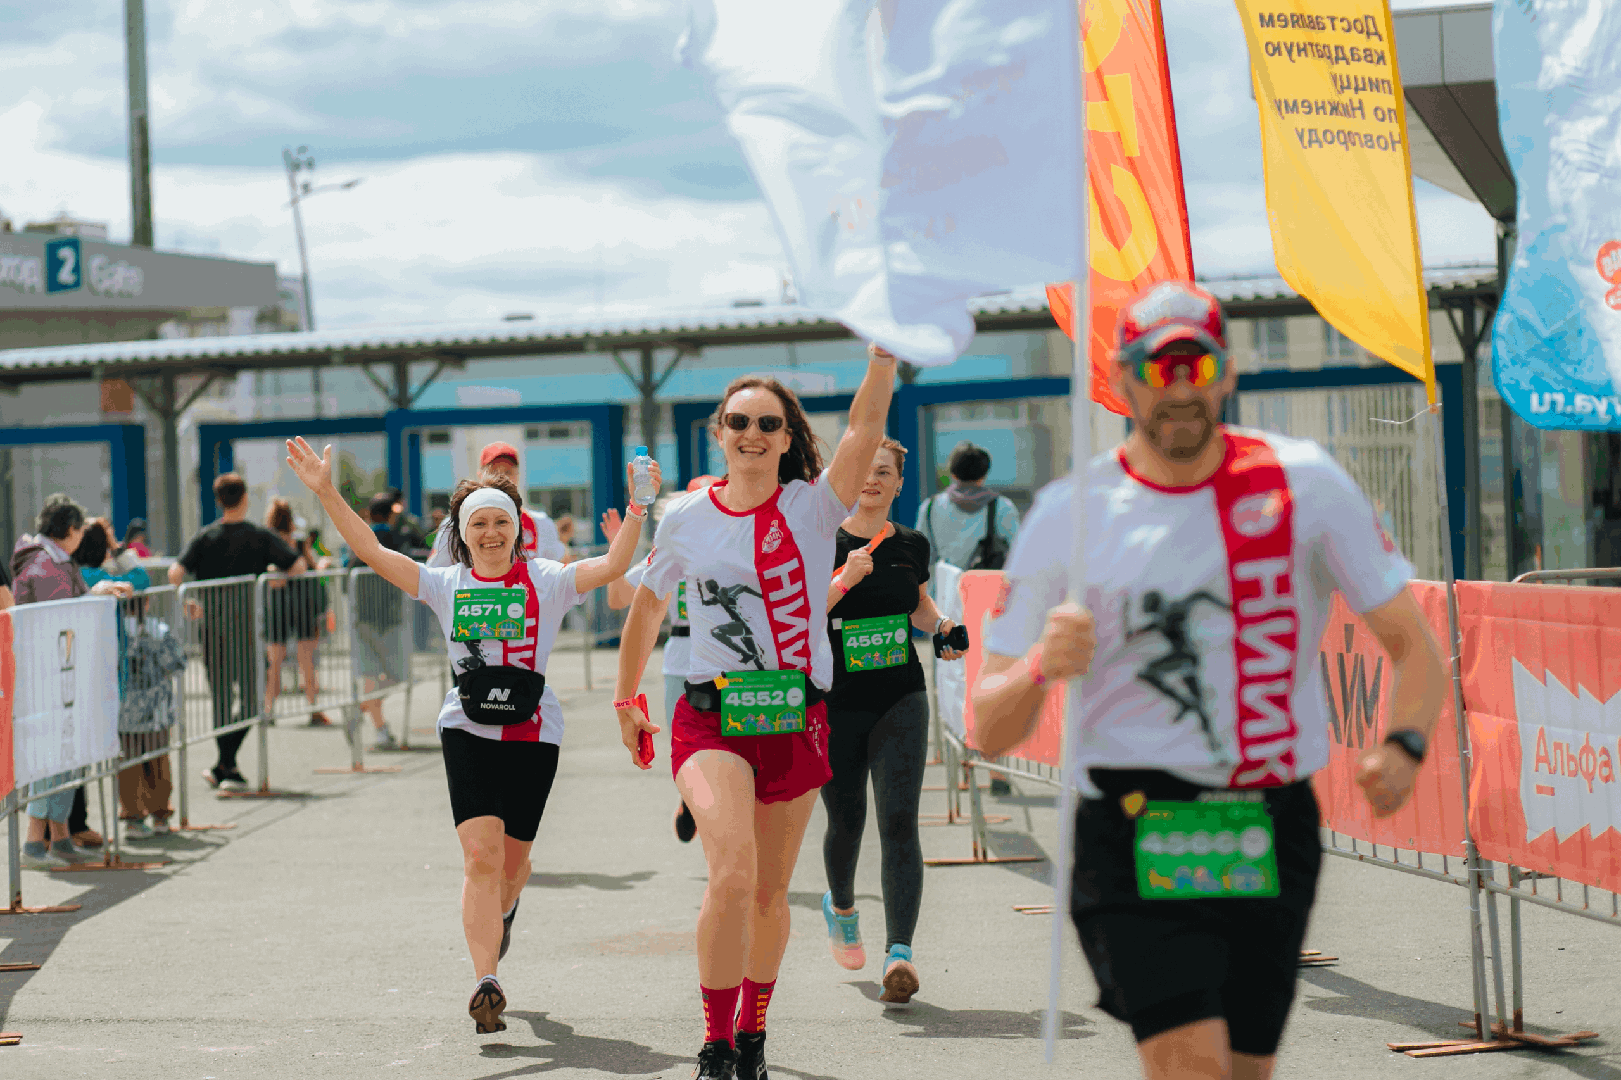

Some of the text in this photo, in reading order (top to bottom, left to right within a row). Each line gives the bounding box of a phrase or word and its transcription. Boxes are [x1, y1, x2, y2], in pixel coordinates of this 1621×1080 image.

[56, 246, 77, 285] 2
[457, 603, 503, 618] 4571
[846, 631, 894, 649] 4567
[480, 702, 516, 711] NOVAROLL
[725, 690, 785, 707] 4552
[1534, 725, 1616, 794] Альфа
